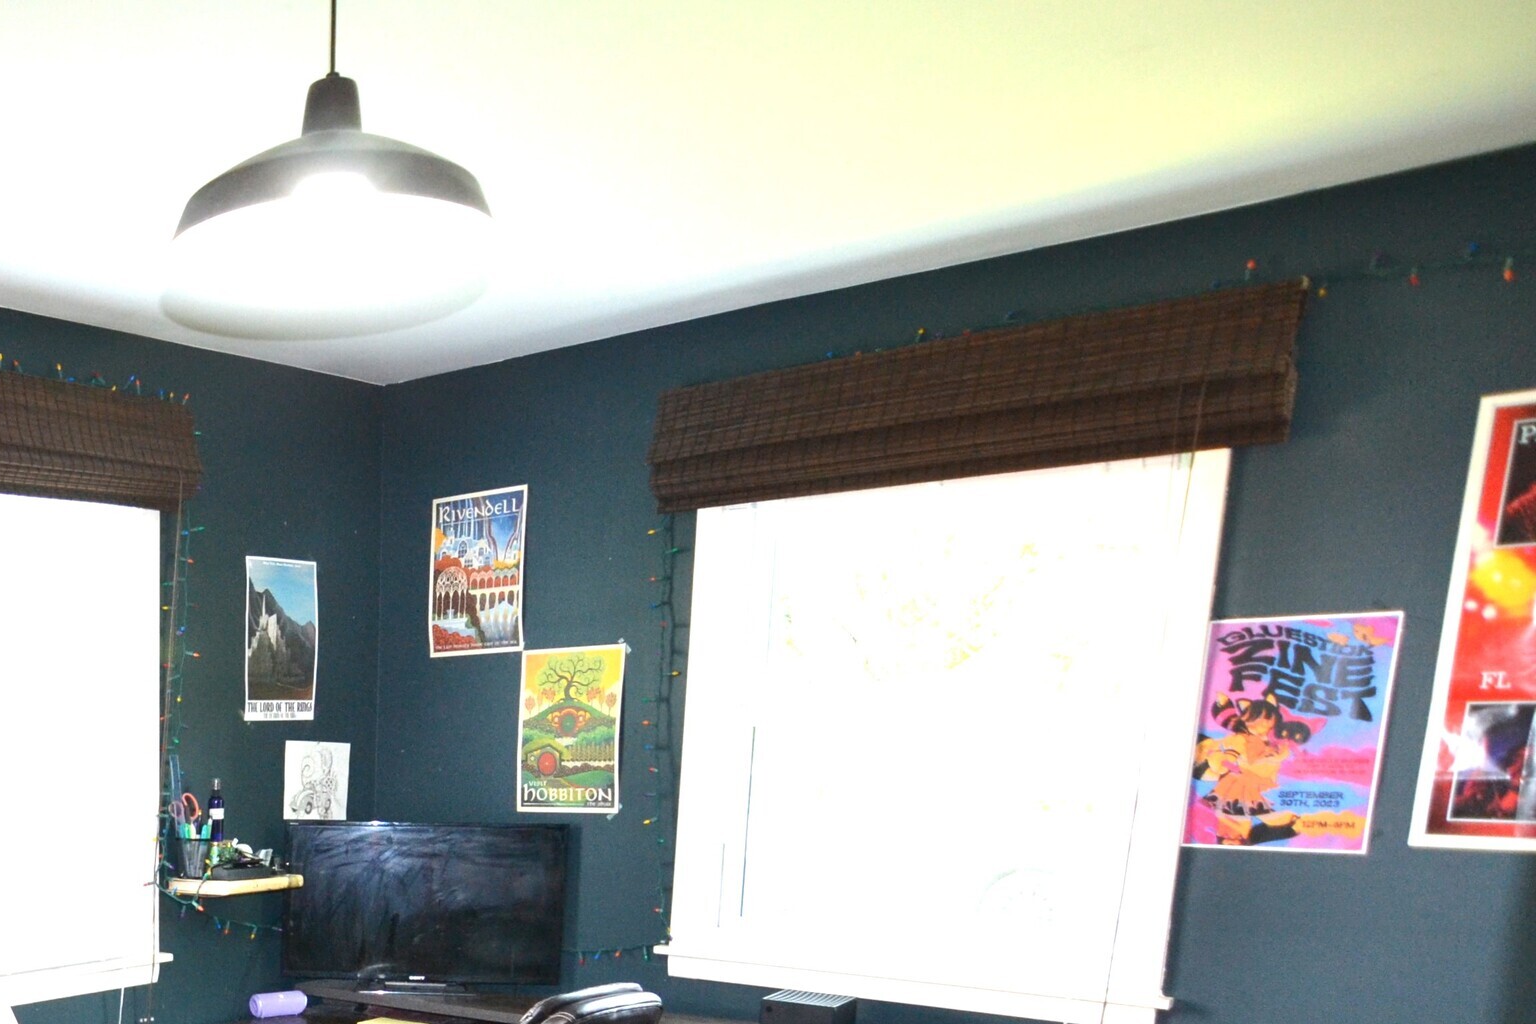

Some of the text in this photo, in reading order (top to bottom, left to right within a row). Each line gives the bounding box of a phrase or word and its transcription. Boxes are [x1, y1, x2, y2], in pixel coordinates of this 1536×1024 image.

[438, 498, 520, 523] RIVENDELL
[1220, 639, 1376, 687] ZINE
[1229, 664, 1377, 722] FEST
[248, 702, 258, 712] THE
[260, 702, 274, 712] LORD
[276, 702, 282, 712] OF
[285, 702, 296, 712] THE
[1278, 791, 1344, 800] SEPTEMBER
[1279, 799, 1341, 808] 30TH, 2023
